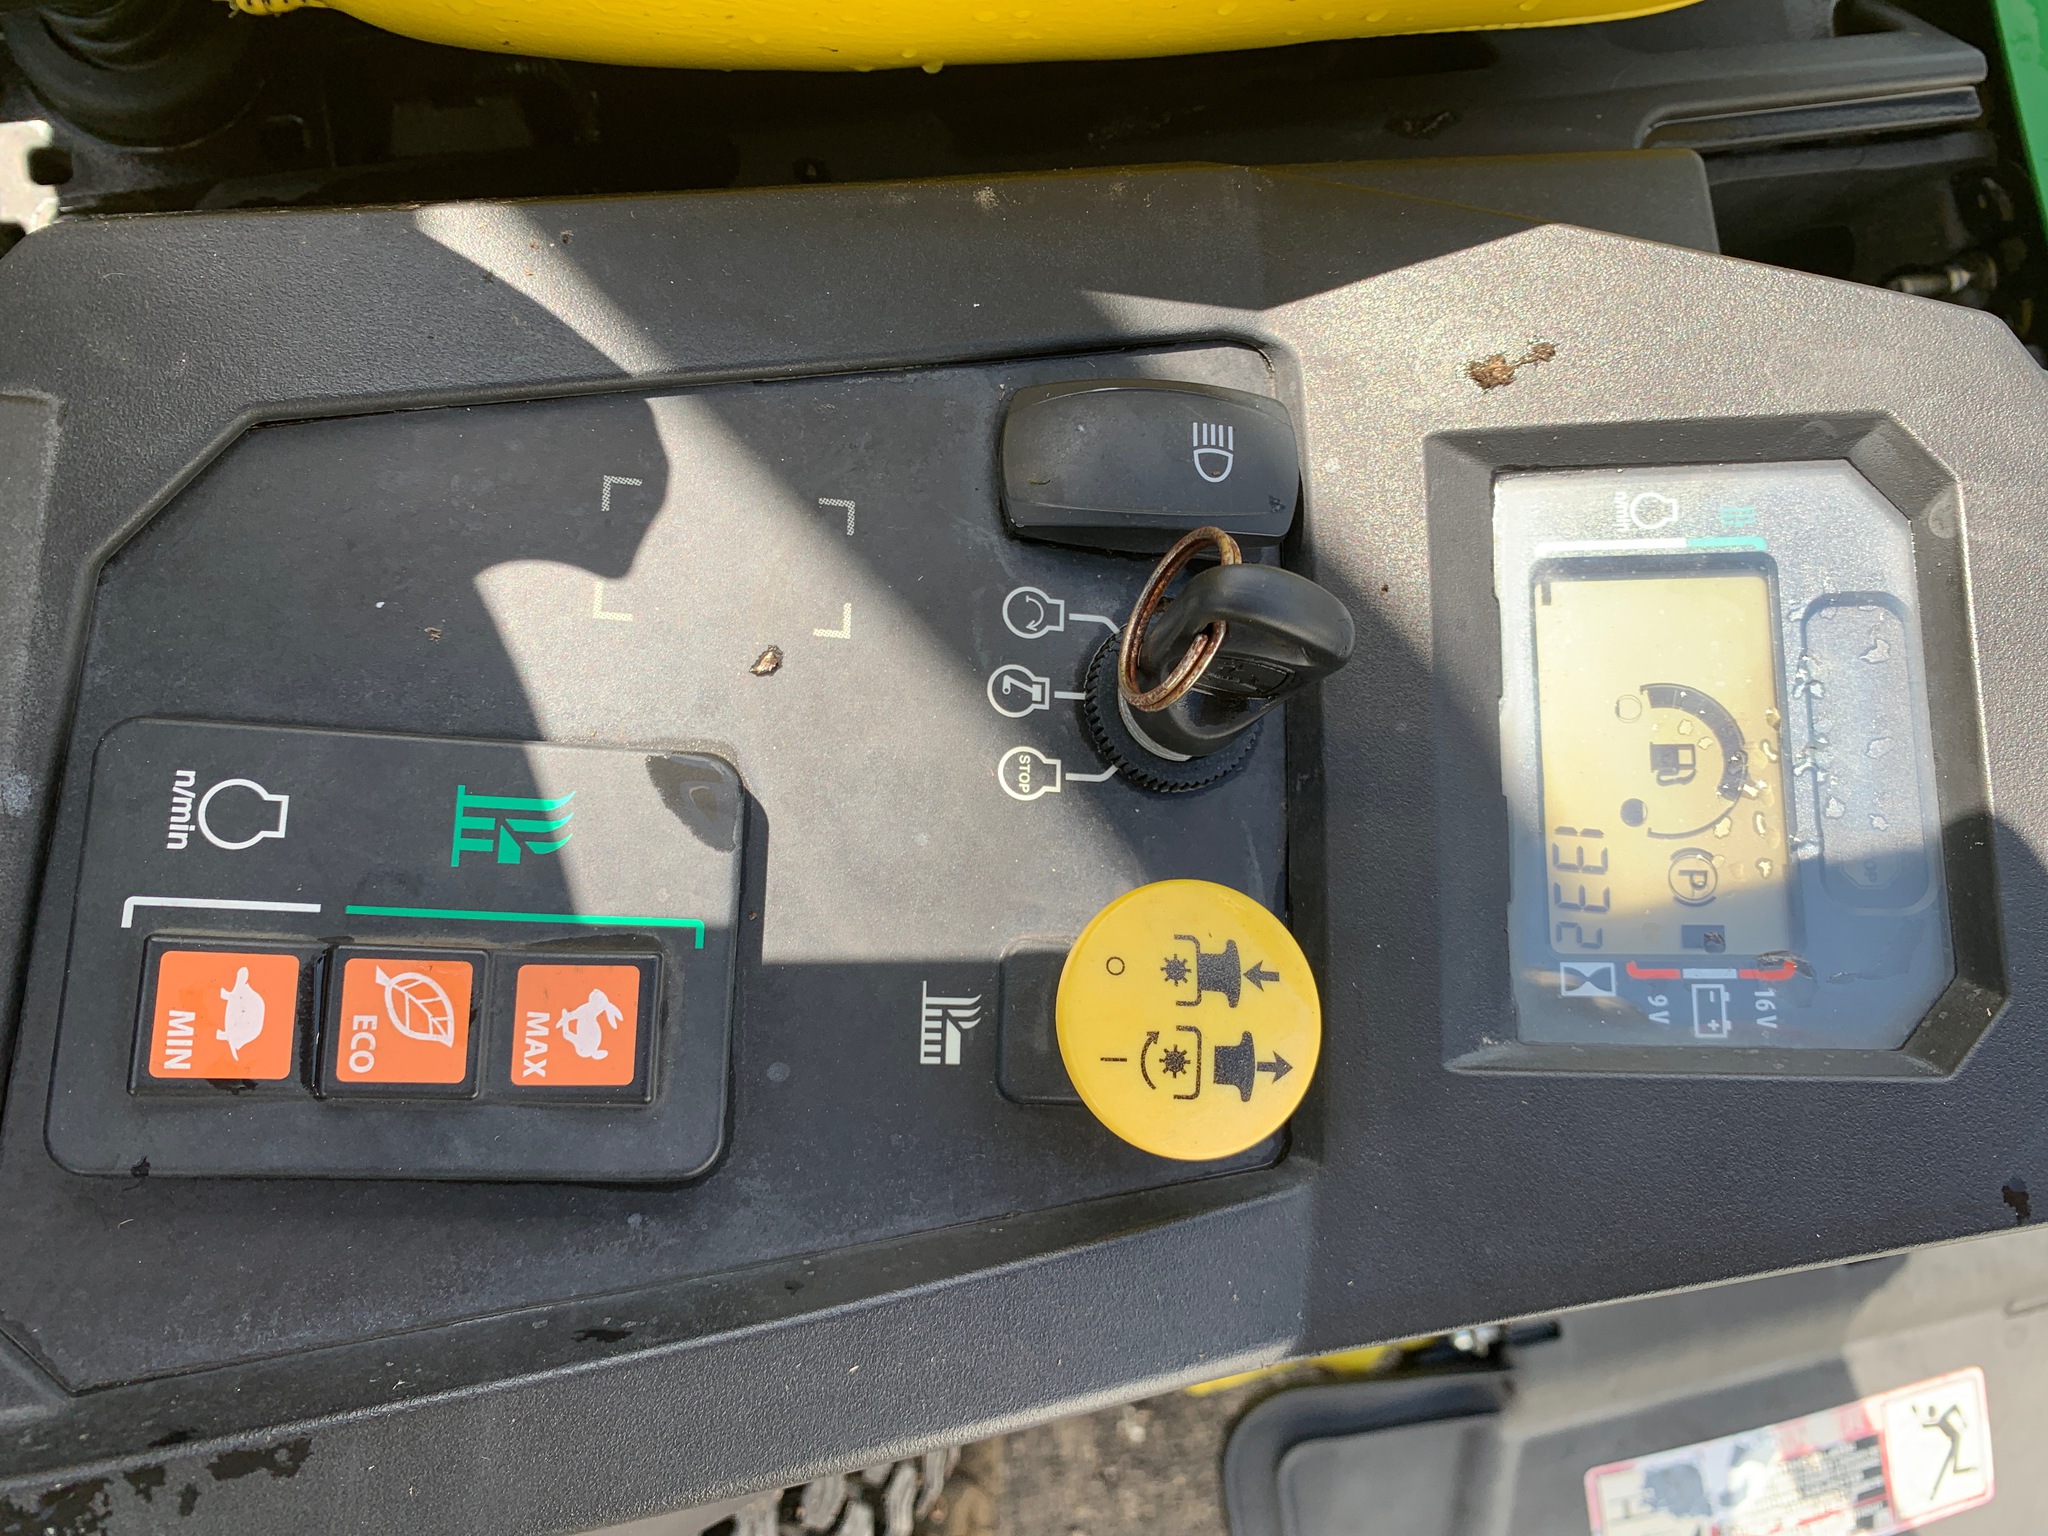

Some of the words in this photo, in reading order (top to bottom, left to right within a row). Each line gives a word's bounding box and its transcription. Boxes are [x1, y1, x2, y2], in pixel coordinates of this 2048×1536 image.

[1018, 754, 1031, 793] STOP
[166, 769, 196, 850] n/min
[1678, 869, 1708, 891] P
[1647, 993, 1671, 1025] 9V
[1754, 987, 1778, 1029] 16V
[163, 1009, 196, 1070] MIN
[348, 1014, 378, 1073] ECO
[522, 1010, 551, 1078] MAX
